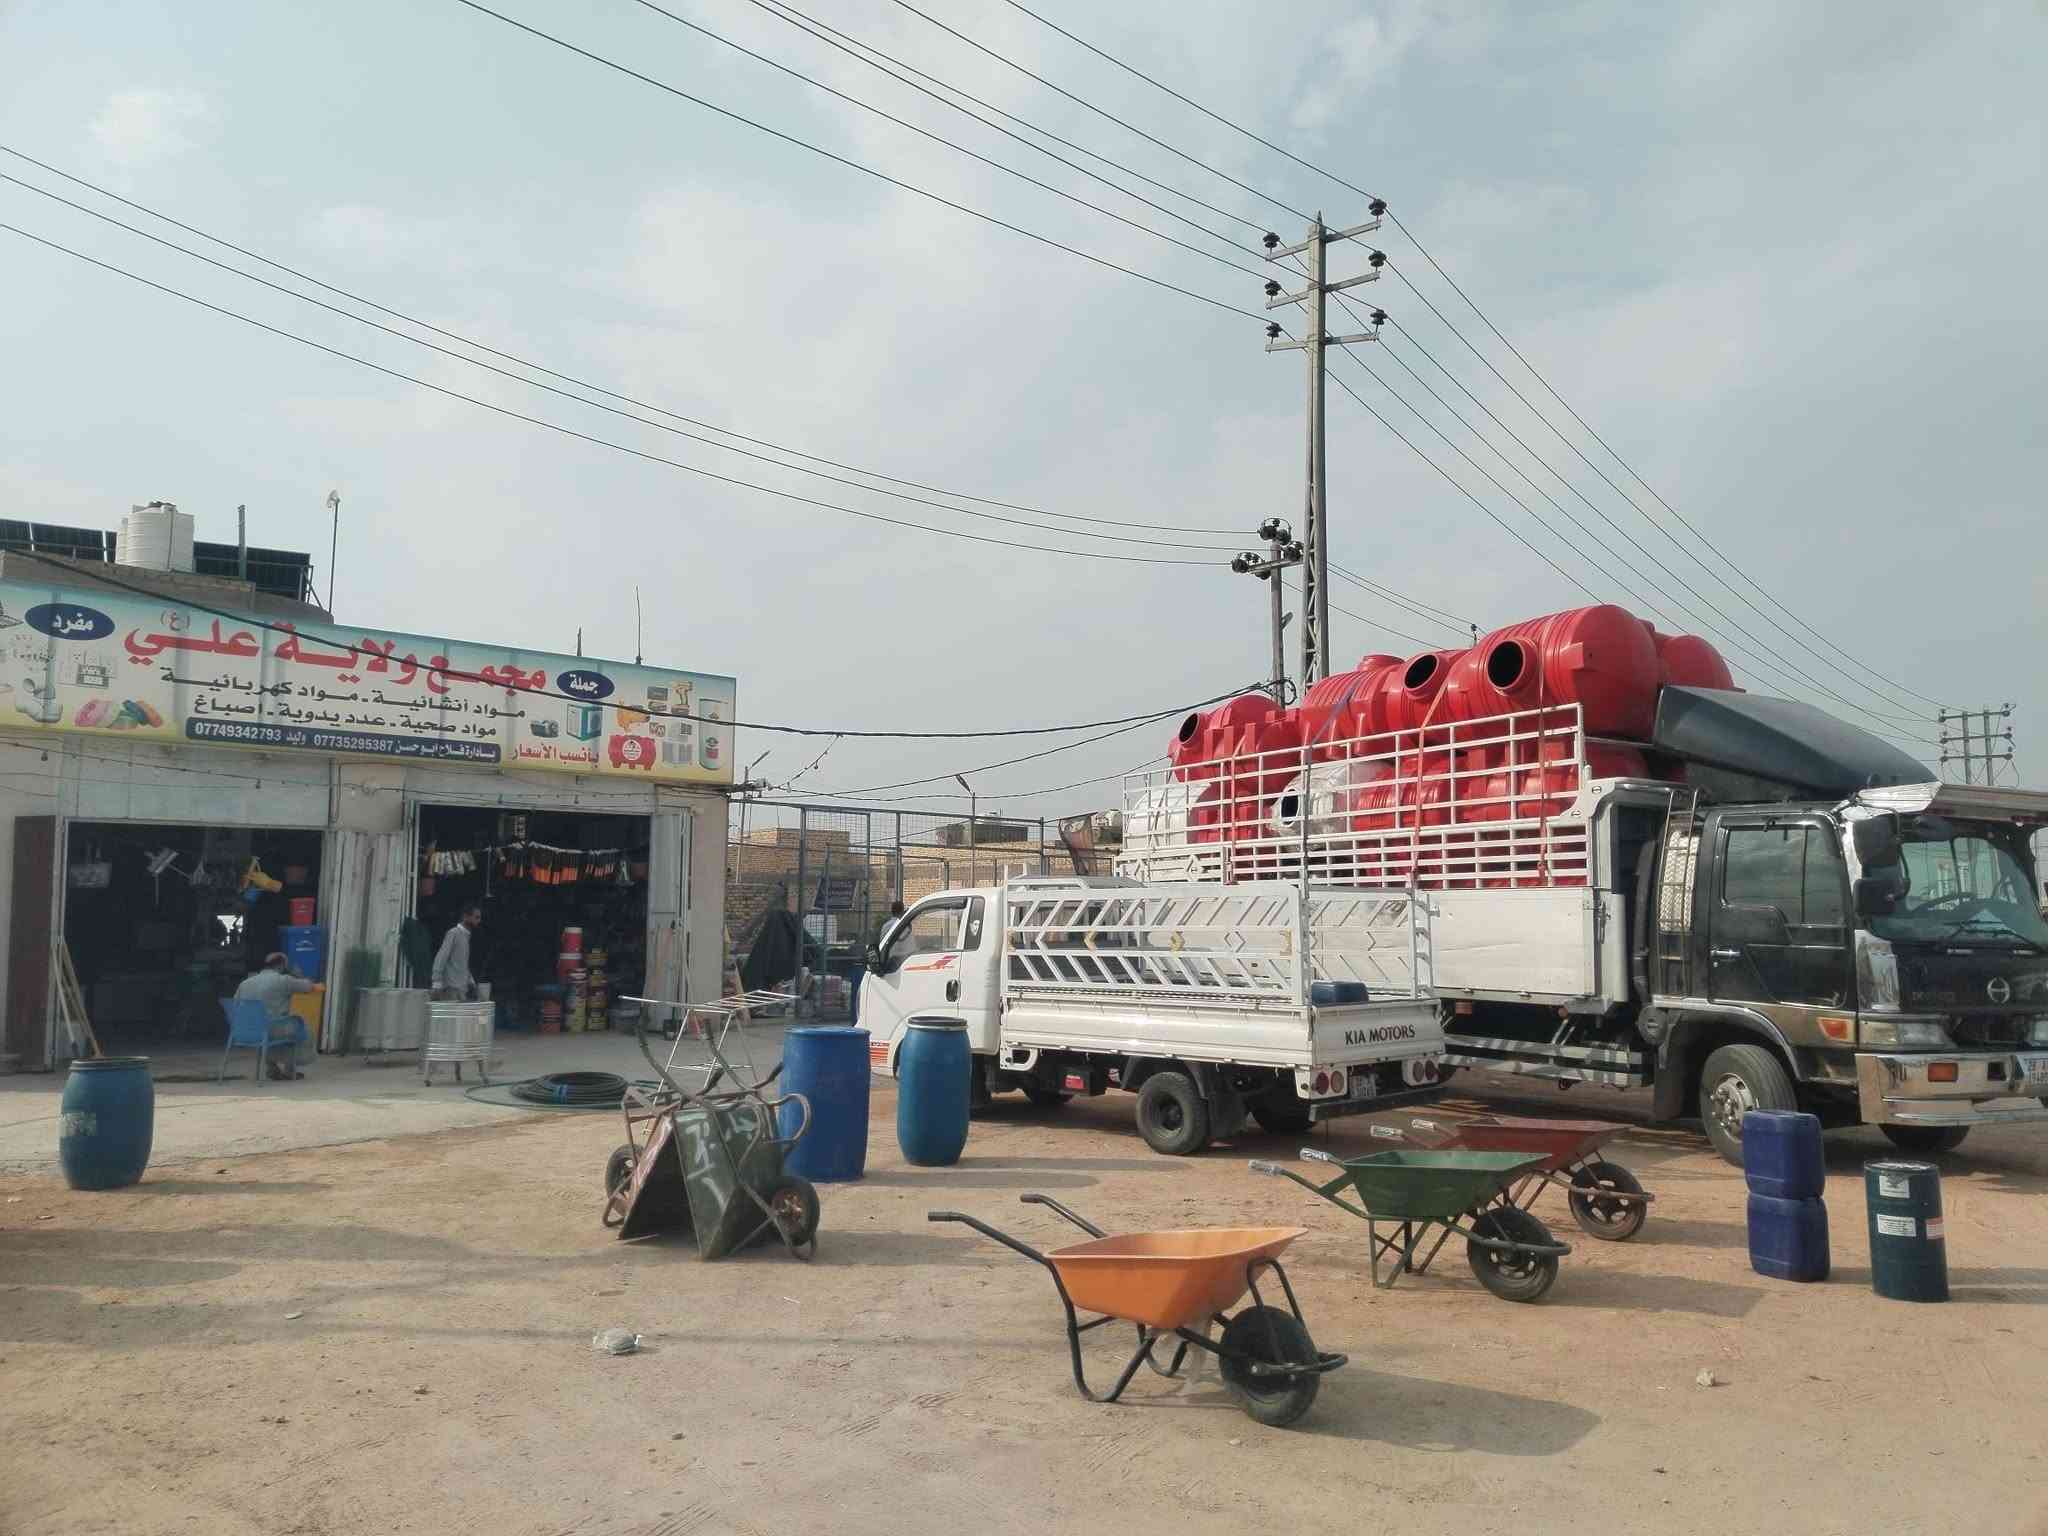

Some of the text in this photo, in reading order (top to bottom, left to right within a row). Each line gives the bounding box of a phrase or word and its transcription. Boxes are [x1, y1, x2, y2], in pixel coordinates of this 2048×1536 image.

[51, 613, 95, 634] مفرد
[124, 617, 259, 667] علي
[272, 621, 418, 686] ولاية
[160, 667, 293, 697] كهربائية
[427, 653, 546, 697] مجمع
[569, 673, 599, 695] جملة
[297, 685, 359, 702] مواد
[278, 702, 340, 727] يدوية
[345, 713, 386, 727] عدد
[473, 703, 526, 719] مواد
[194, 721, 282, 741] 07749342793
[399, 714, 457, 734] صحية
[461, 723, 497, 738] مواد
[313, 733, 394, 752] 07735295387
[1345, 1024, 1416, 1045] KIA MOTORS
